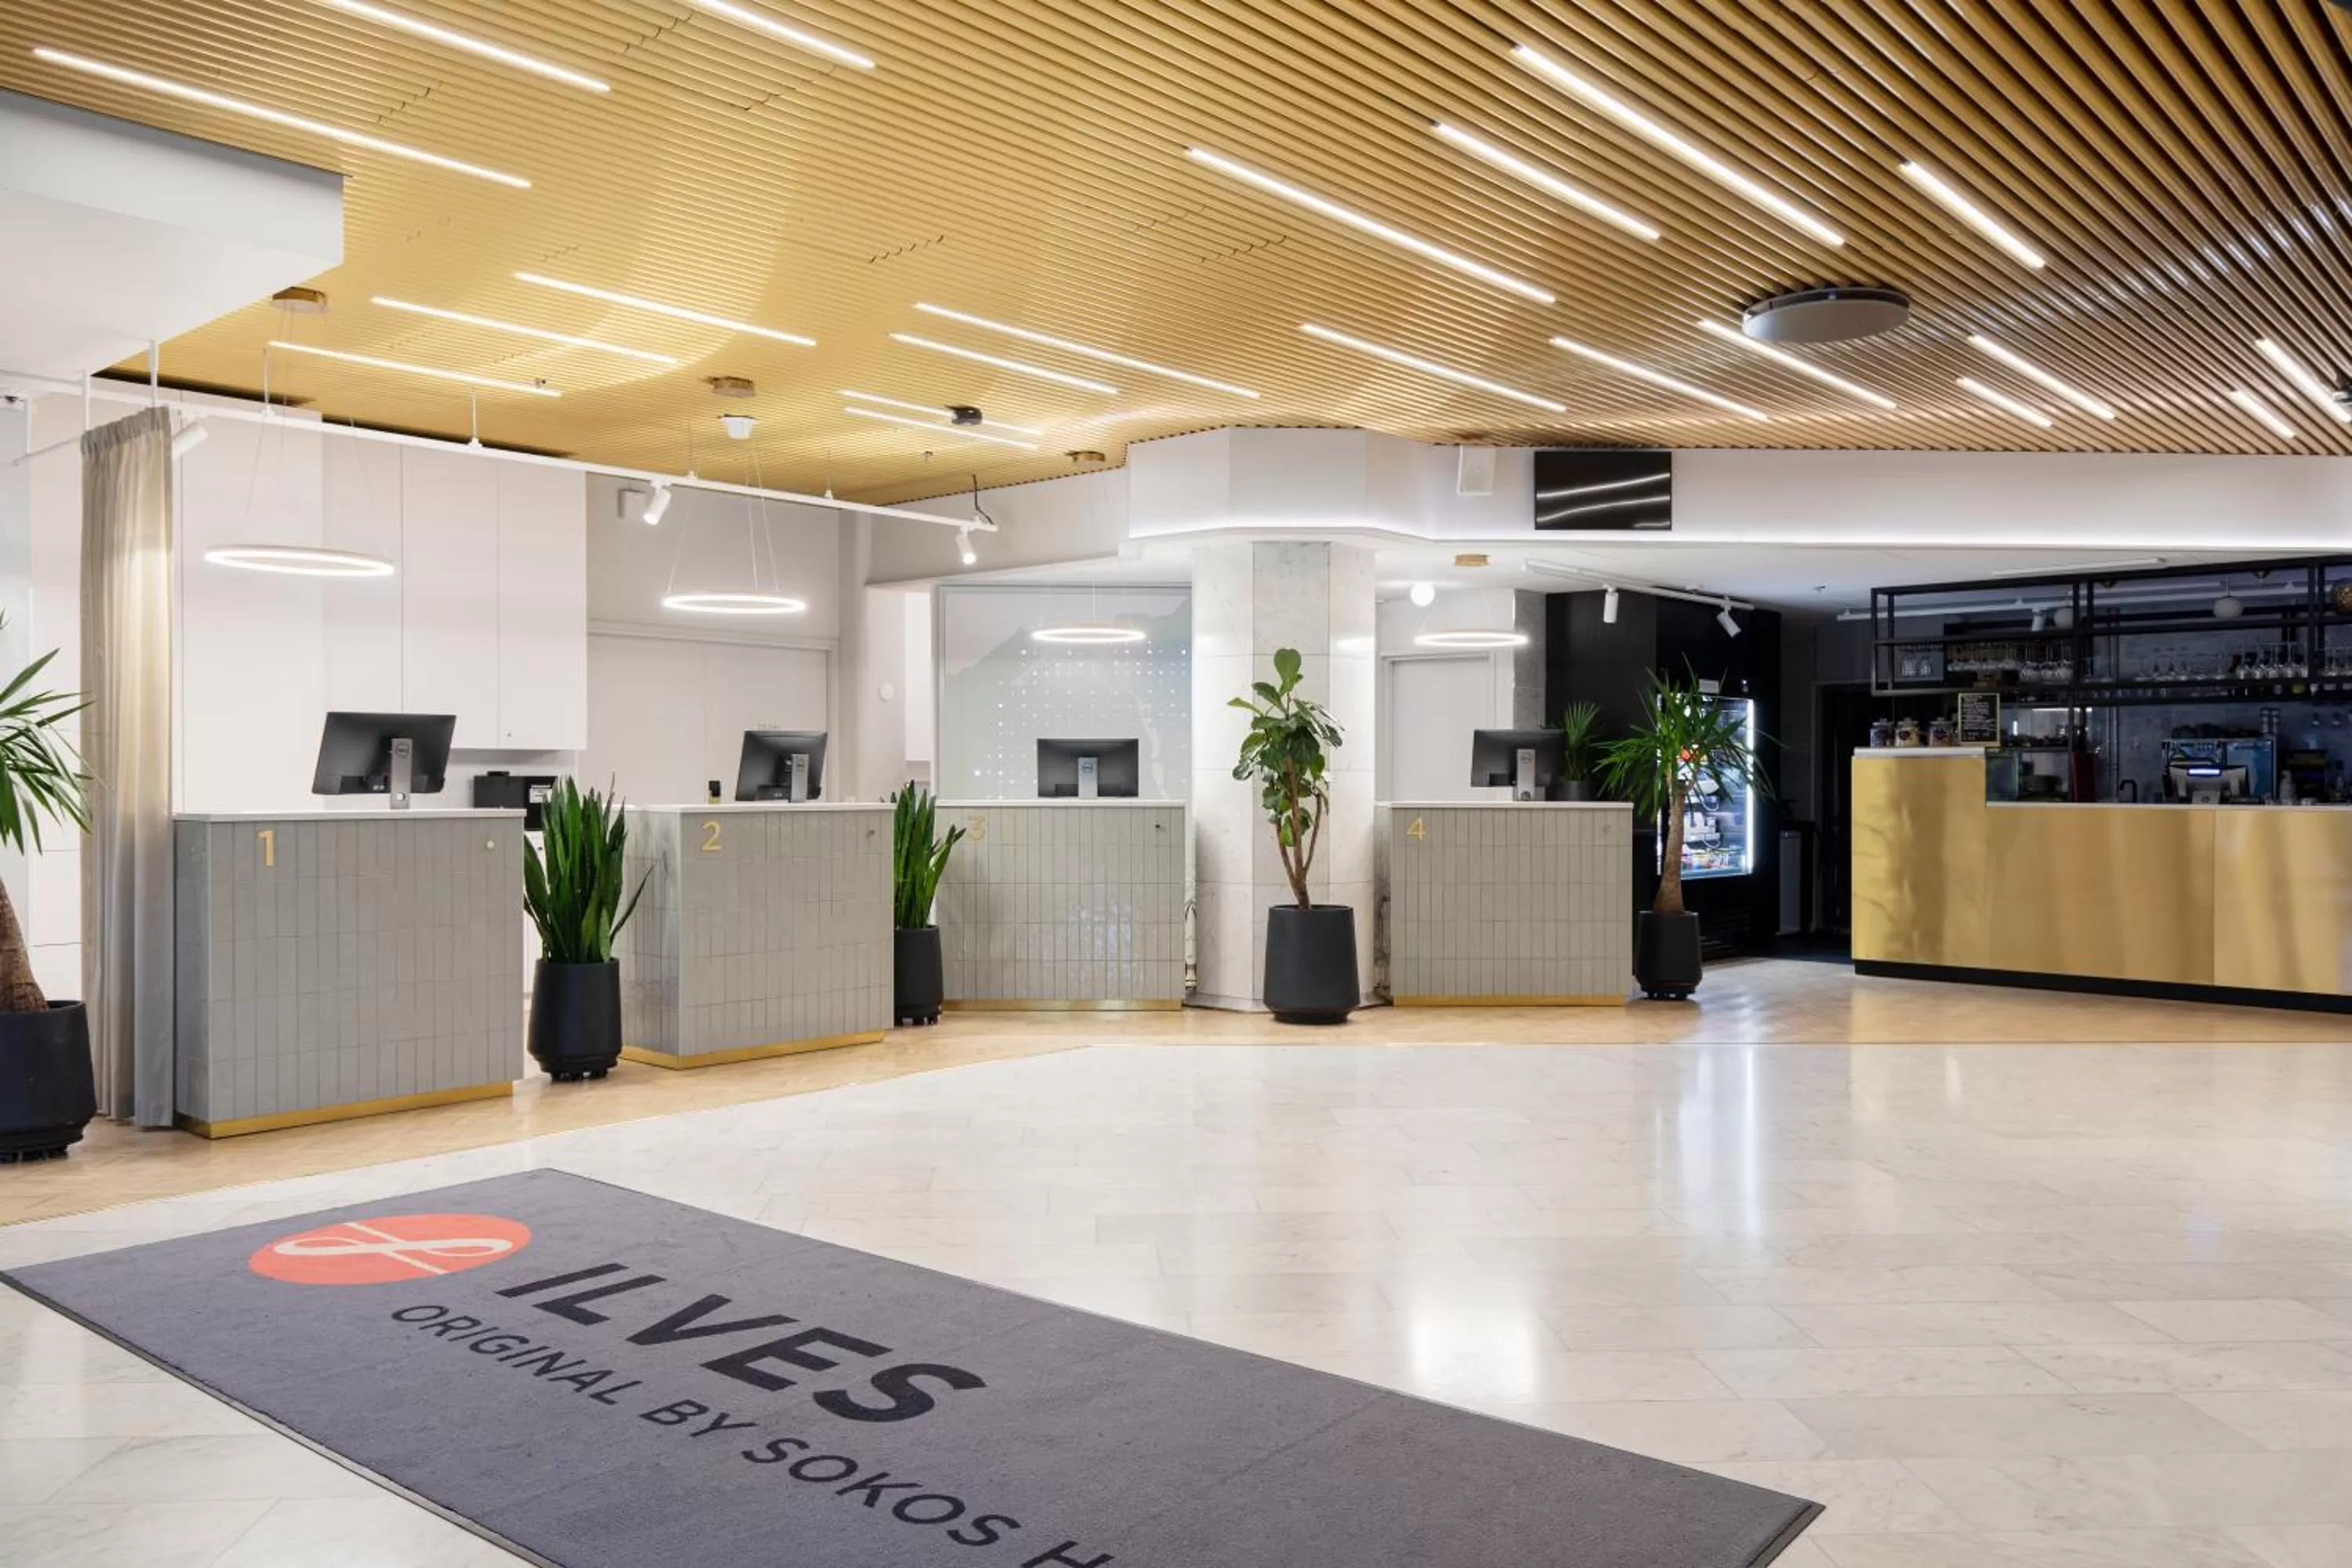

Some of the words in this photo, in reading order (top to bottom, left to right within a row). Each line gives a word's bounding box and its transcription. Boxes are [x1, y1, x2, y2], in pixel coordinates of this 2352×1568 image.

[702, 821, 722, 851] 2
[967, 815, 985, 842] 3
[1406, 816, 1427, 840] 4
[258, 829, 274, 866] 1
[495, 1262, 987, 1423] ILVES
[391, 1305, 642, 1405] ORIGINAL
[639, 1399, 757, 1438] BY
[741, 1437, 1022, 1547] SOKOS
